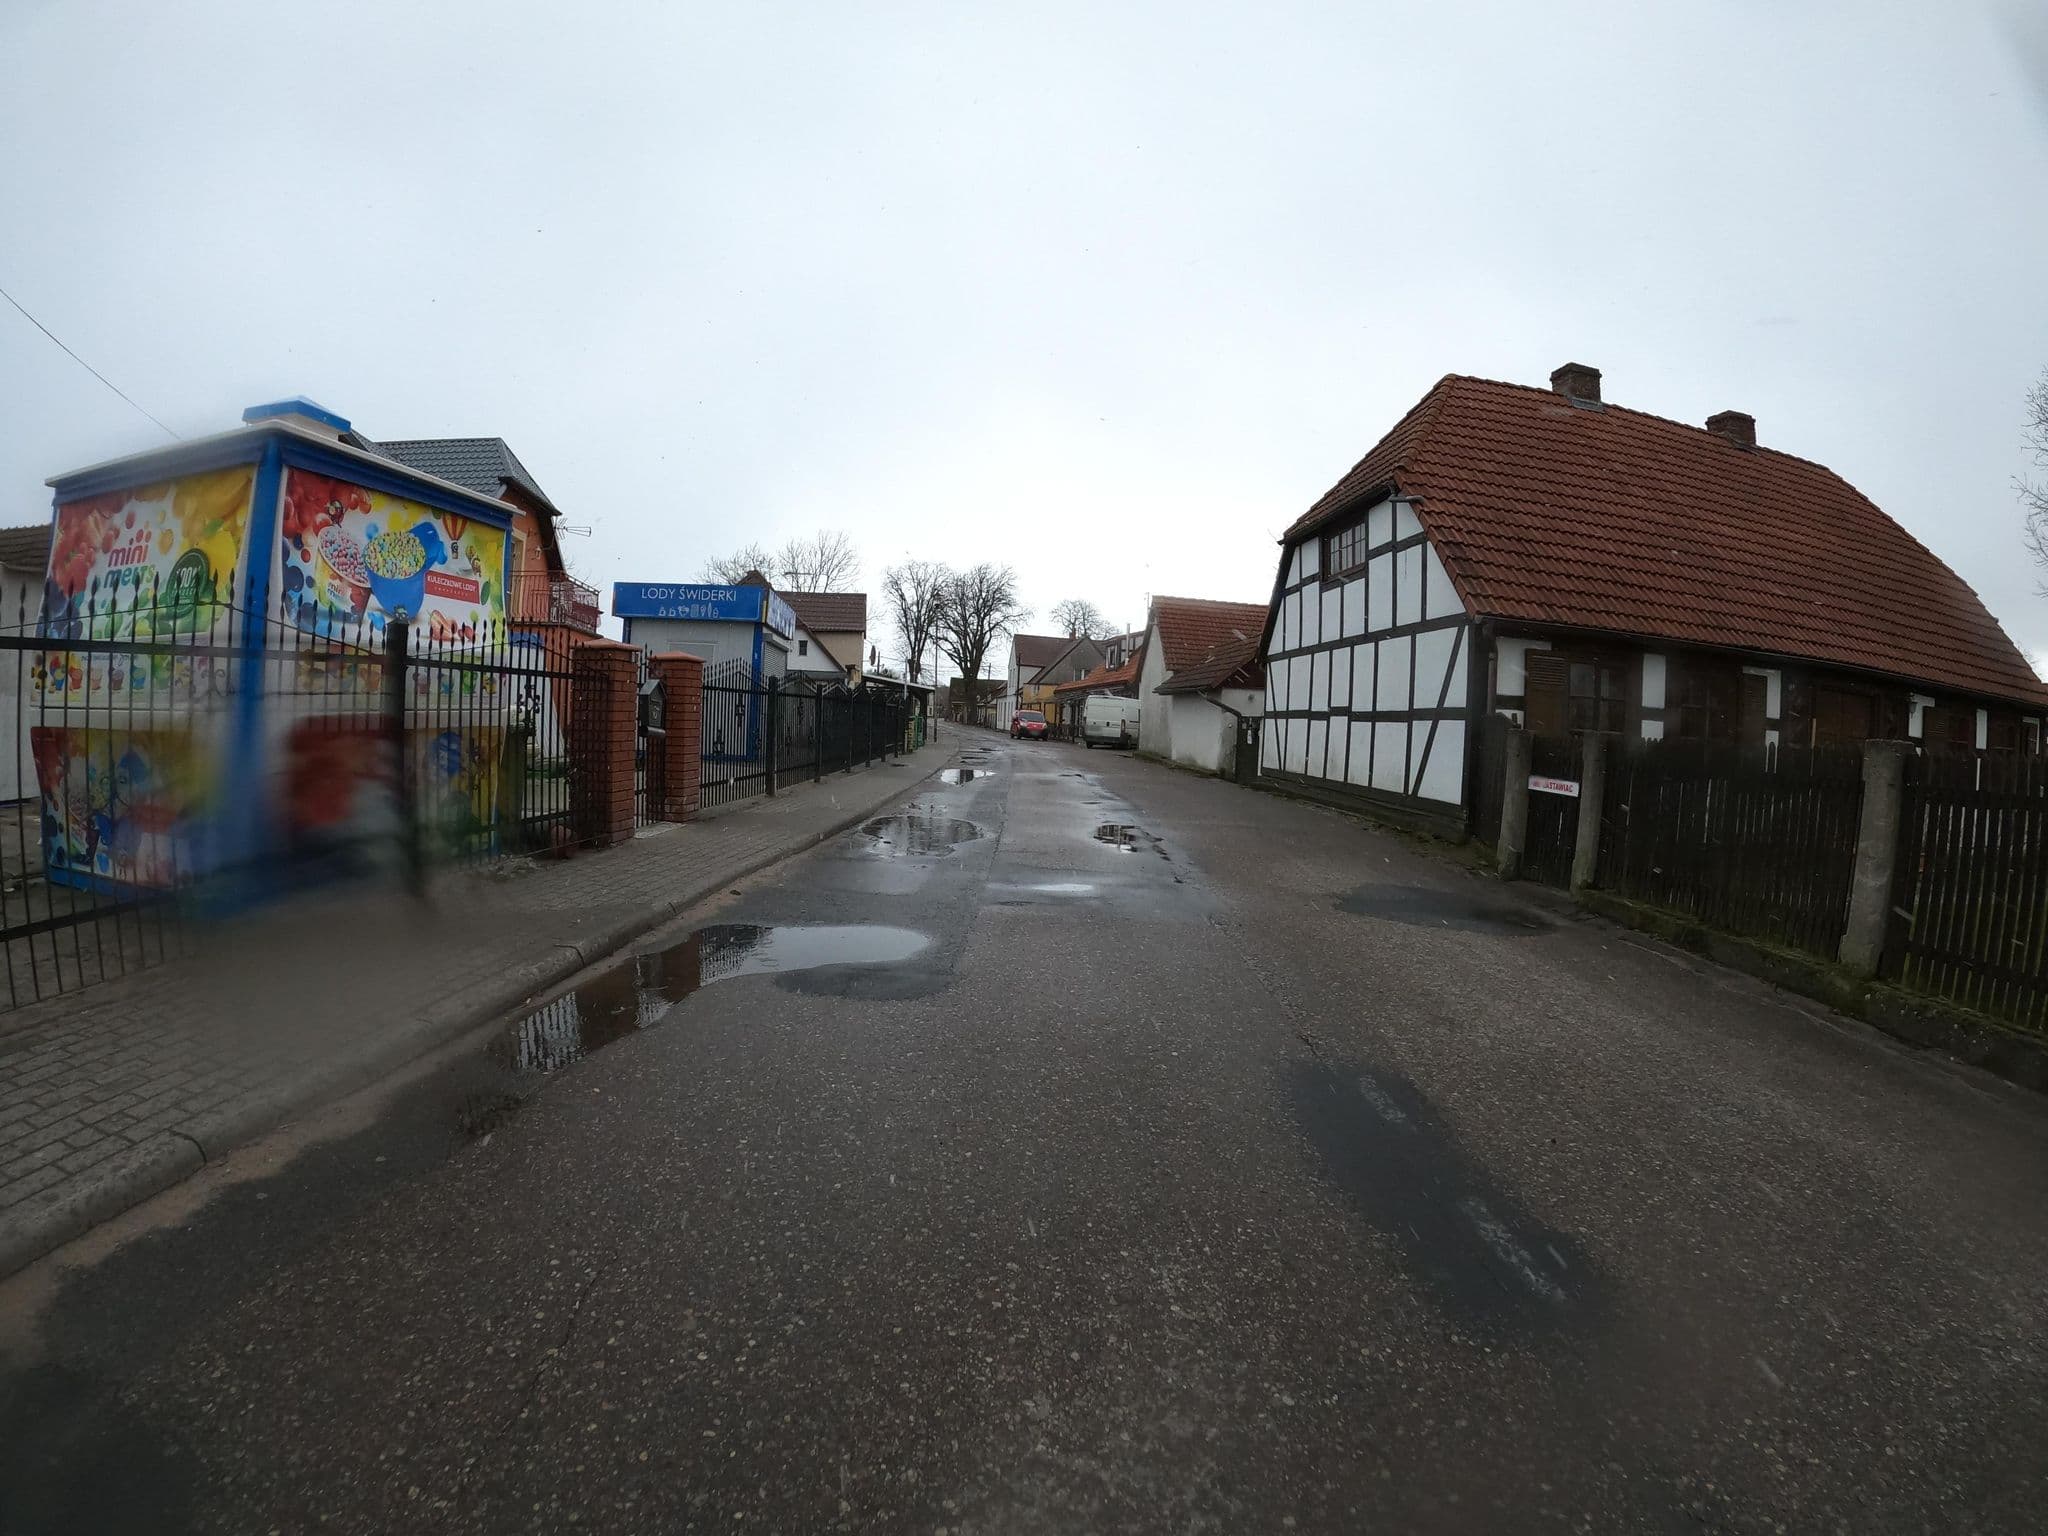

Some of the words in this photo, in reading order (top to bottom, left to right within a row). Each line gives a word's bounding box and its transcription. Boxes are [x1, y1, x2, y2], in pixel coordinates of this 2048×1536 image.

[108, 530, 151, 567] mini
[641, 587, 676, 599] LODY
[679, 586, 737, 601] ŚWIDERKI
